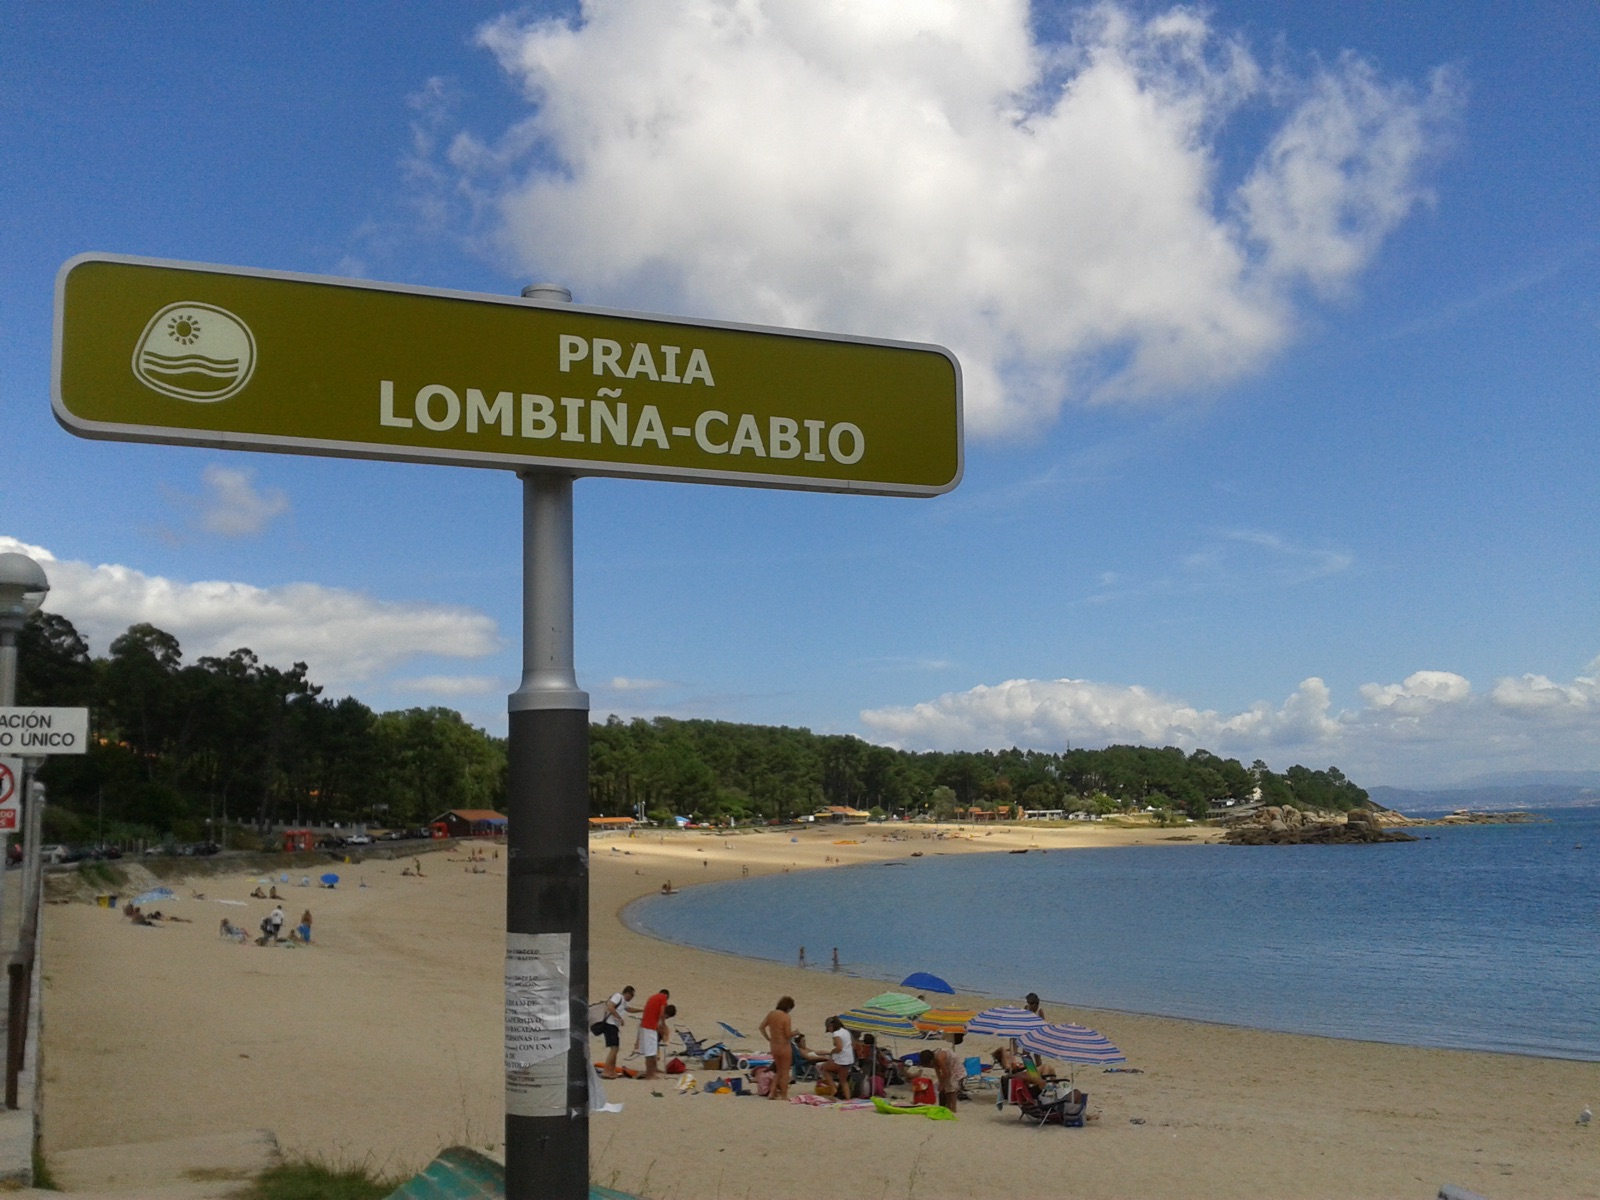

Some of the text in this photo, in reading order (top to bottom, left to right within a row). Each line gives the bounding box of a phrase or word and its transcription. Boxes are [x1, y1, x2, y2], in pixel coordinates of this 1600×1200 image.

[559, 334, 716, 387] PRAIA
[379, 380, 865, 464] LOMBIÑA-CABIO
[0, 711, 52, 729] ACIÓN
[20, 729, 75, 747] ÚNICO
